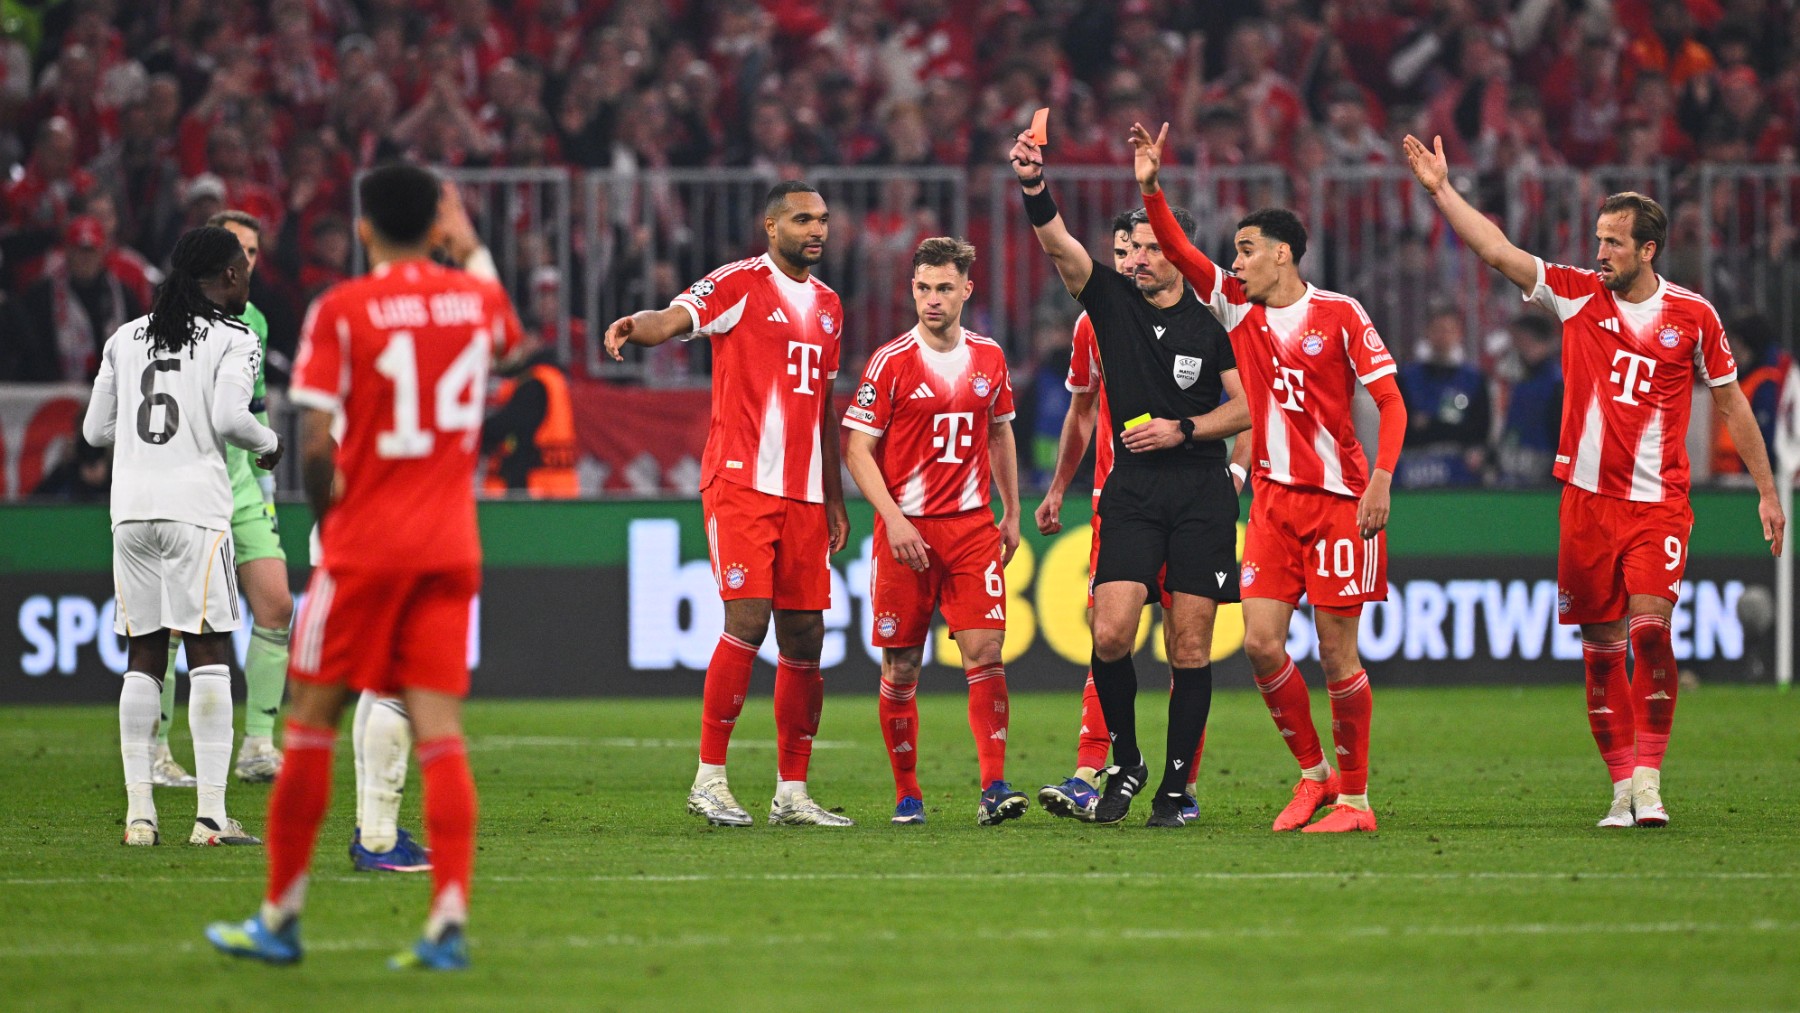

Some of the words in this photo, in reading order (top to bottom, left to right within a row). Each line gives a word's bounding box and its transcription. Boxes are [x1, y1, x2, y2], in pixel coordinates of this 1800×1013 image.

[787, 340, 823, 396] T
[1179, 359, 1196, 368] UEFA
[1370, 353, 1394, 365] Allian
[1609, 348, 1657, 407] T
[136, 358, 181, 446] 6
[374, 328, 490, 459] 14
[933, 412, 974, 464] T
[984, 560, 1003, 598] 6
[1315, 538, 1355, 578] 10
[1664, 535, 1682, 571] 9
[628, 518, 1246, 670] b36
